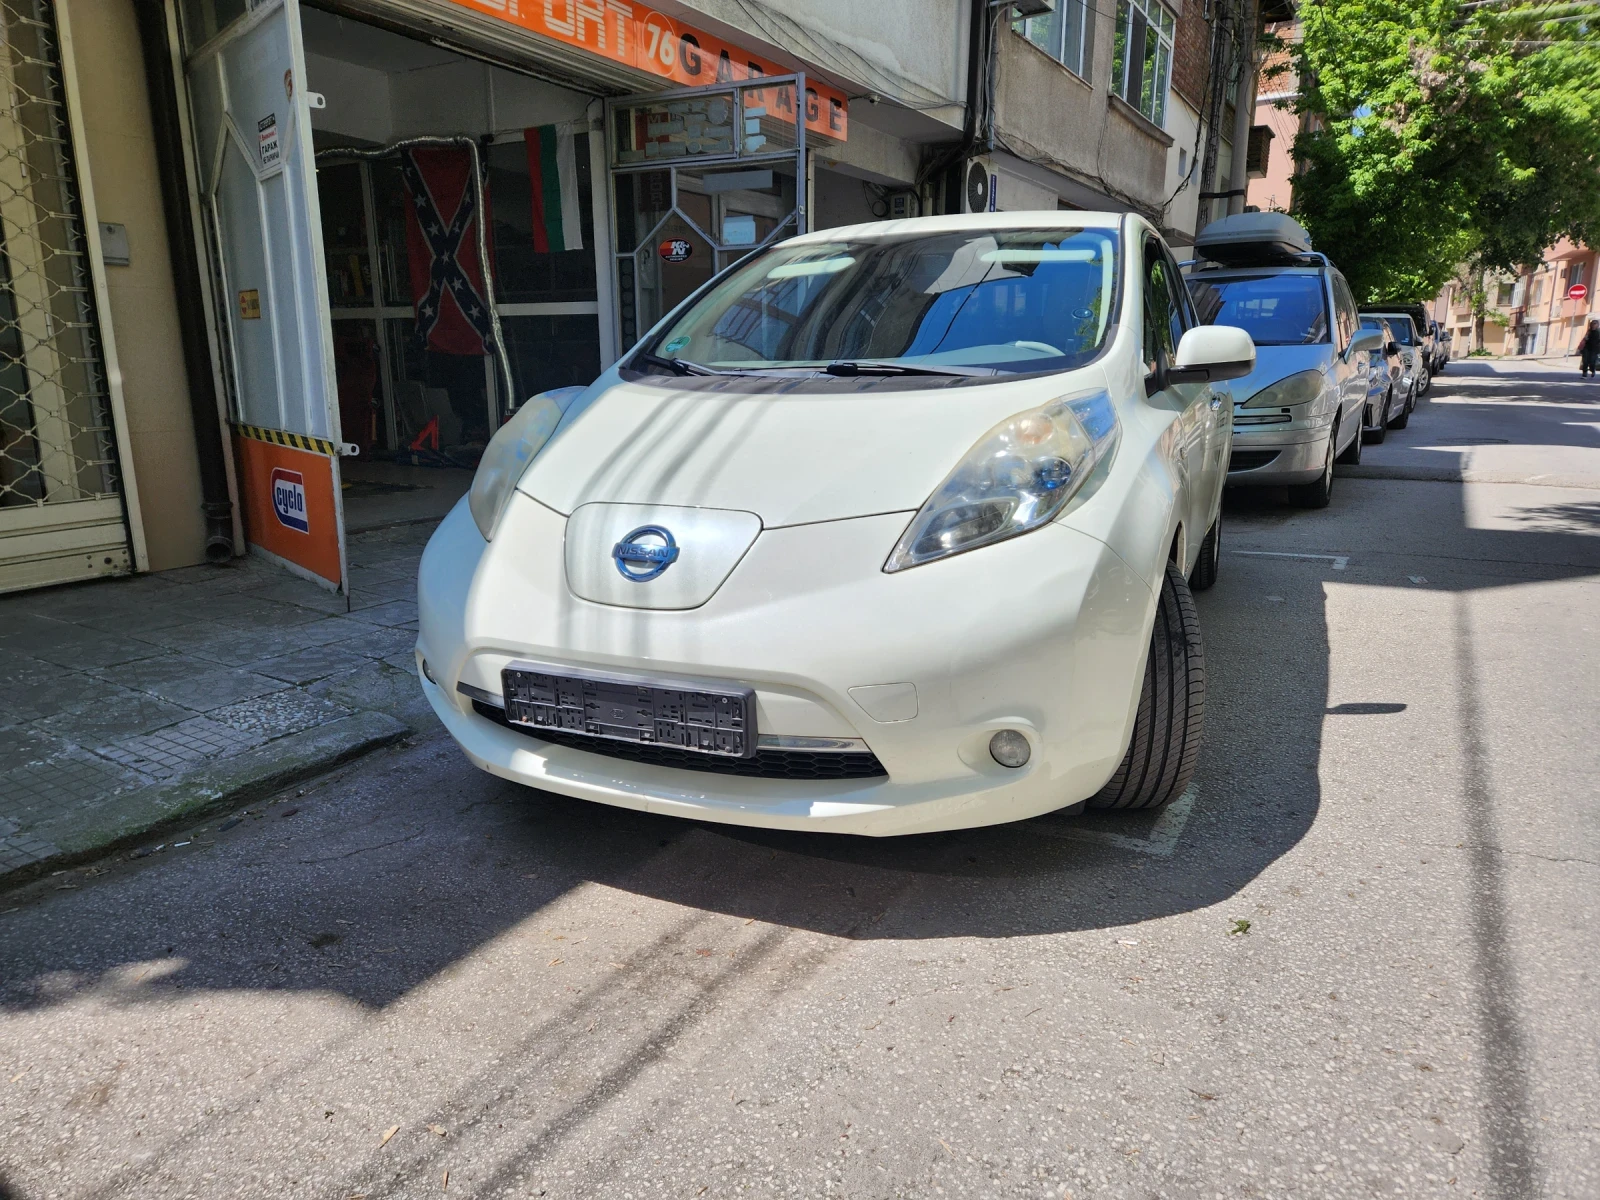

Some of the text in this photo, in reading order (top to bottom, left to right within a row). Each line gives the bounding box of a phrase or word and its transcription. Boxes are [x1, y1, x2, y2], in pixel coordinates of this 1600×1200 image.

[646, 23, 676, 66] 76
[678, 33, 842, 132] GARAGE
[261, 140, 278, 155] ГАРАЖ
[276, 484, 303, 514] cyclo
[617, 545, 669, 558] NISSAN
